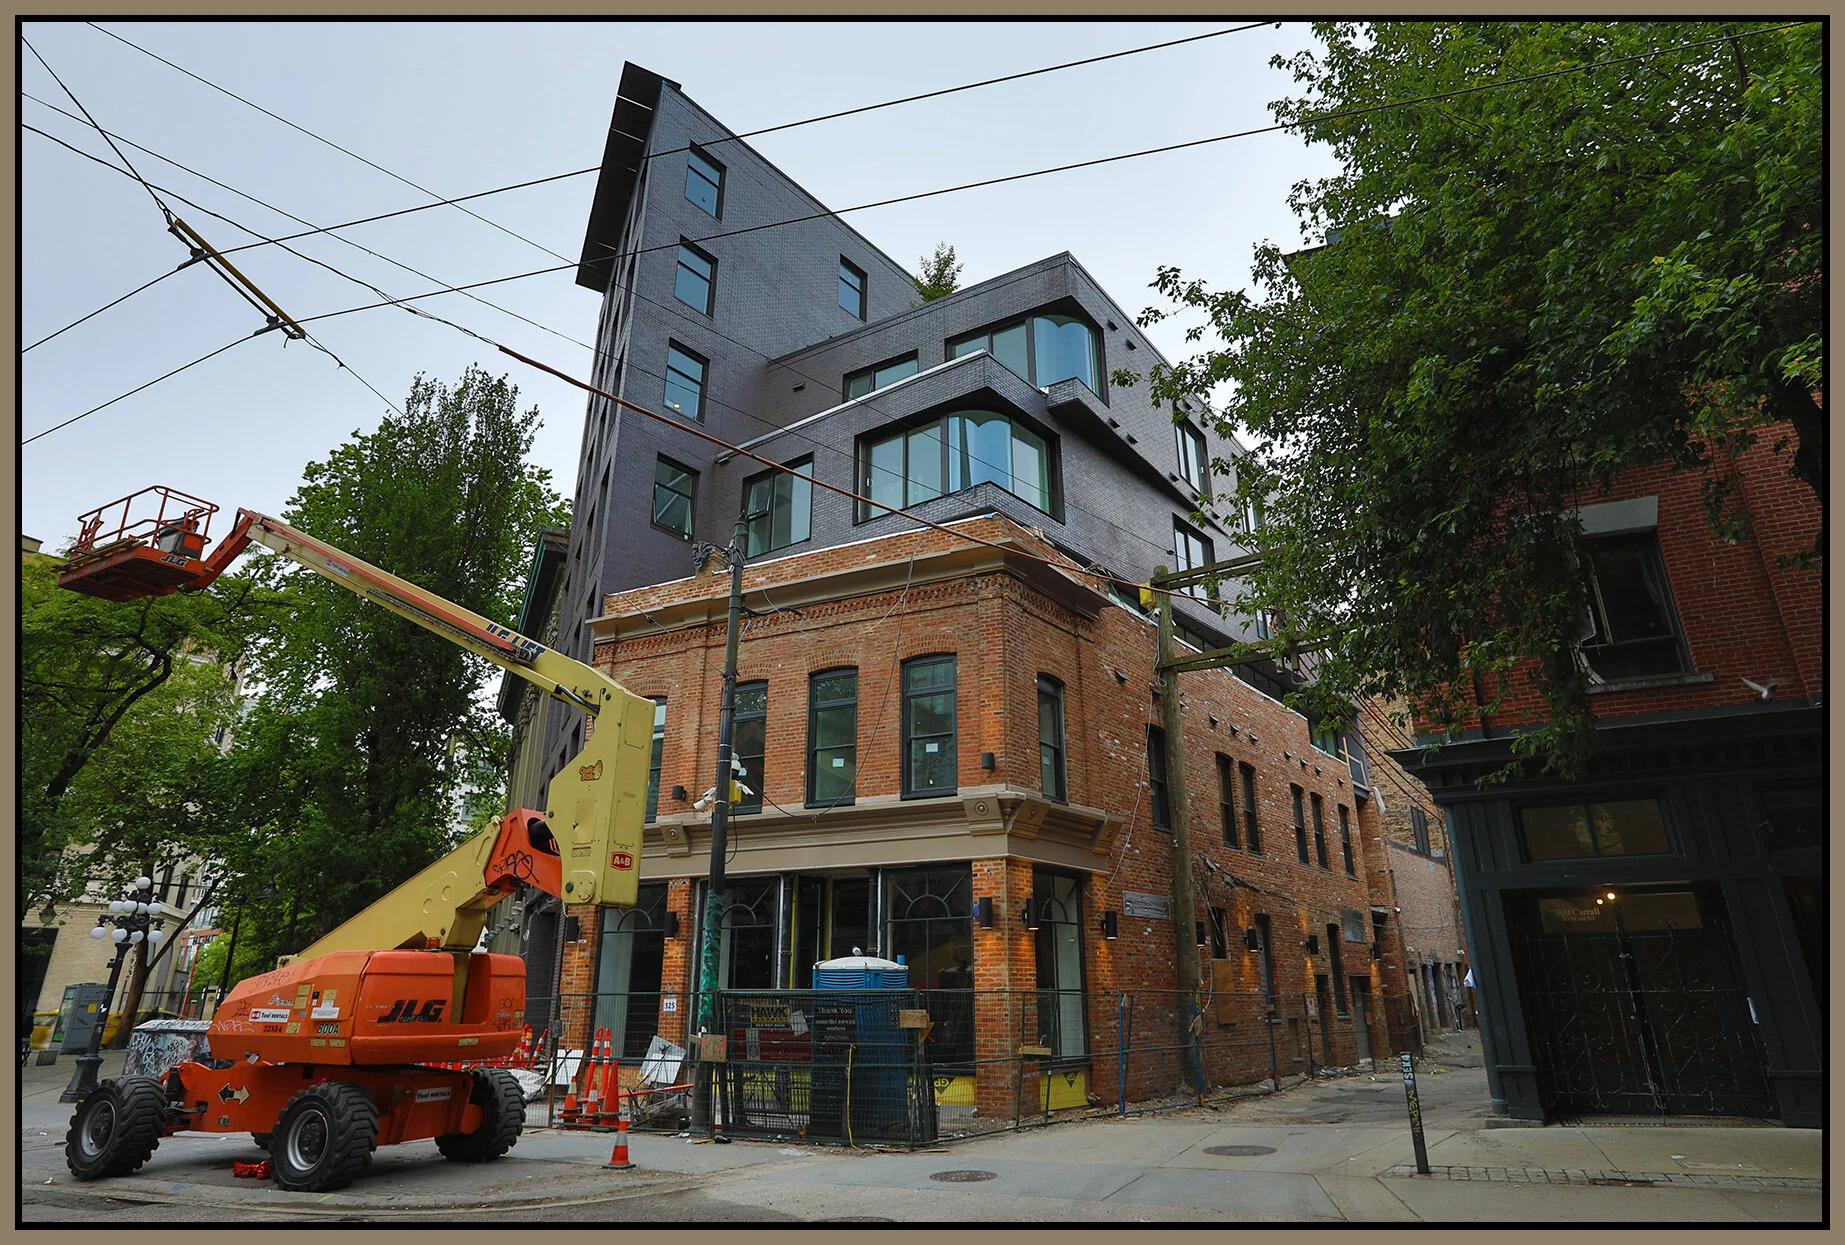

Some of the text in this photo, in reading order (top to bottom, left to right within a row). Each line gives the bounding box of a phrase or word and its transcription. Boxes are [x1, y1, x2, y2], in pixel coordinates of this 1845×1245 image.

[160, 553, 189, 567] JLG
[612, 855, 631, 867] A&B
[377, 999, 448, 1023] JLG
[664, 1002, 675, 1010] 325
[818, 1007, 854, 1015] Thank You
[317, 1023, 339, 1035] 800A
[933, 1077, 950, 1087] GP
